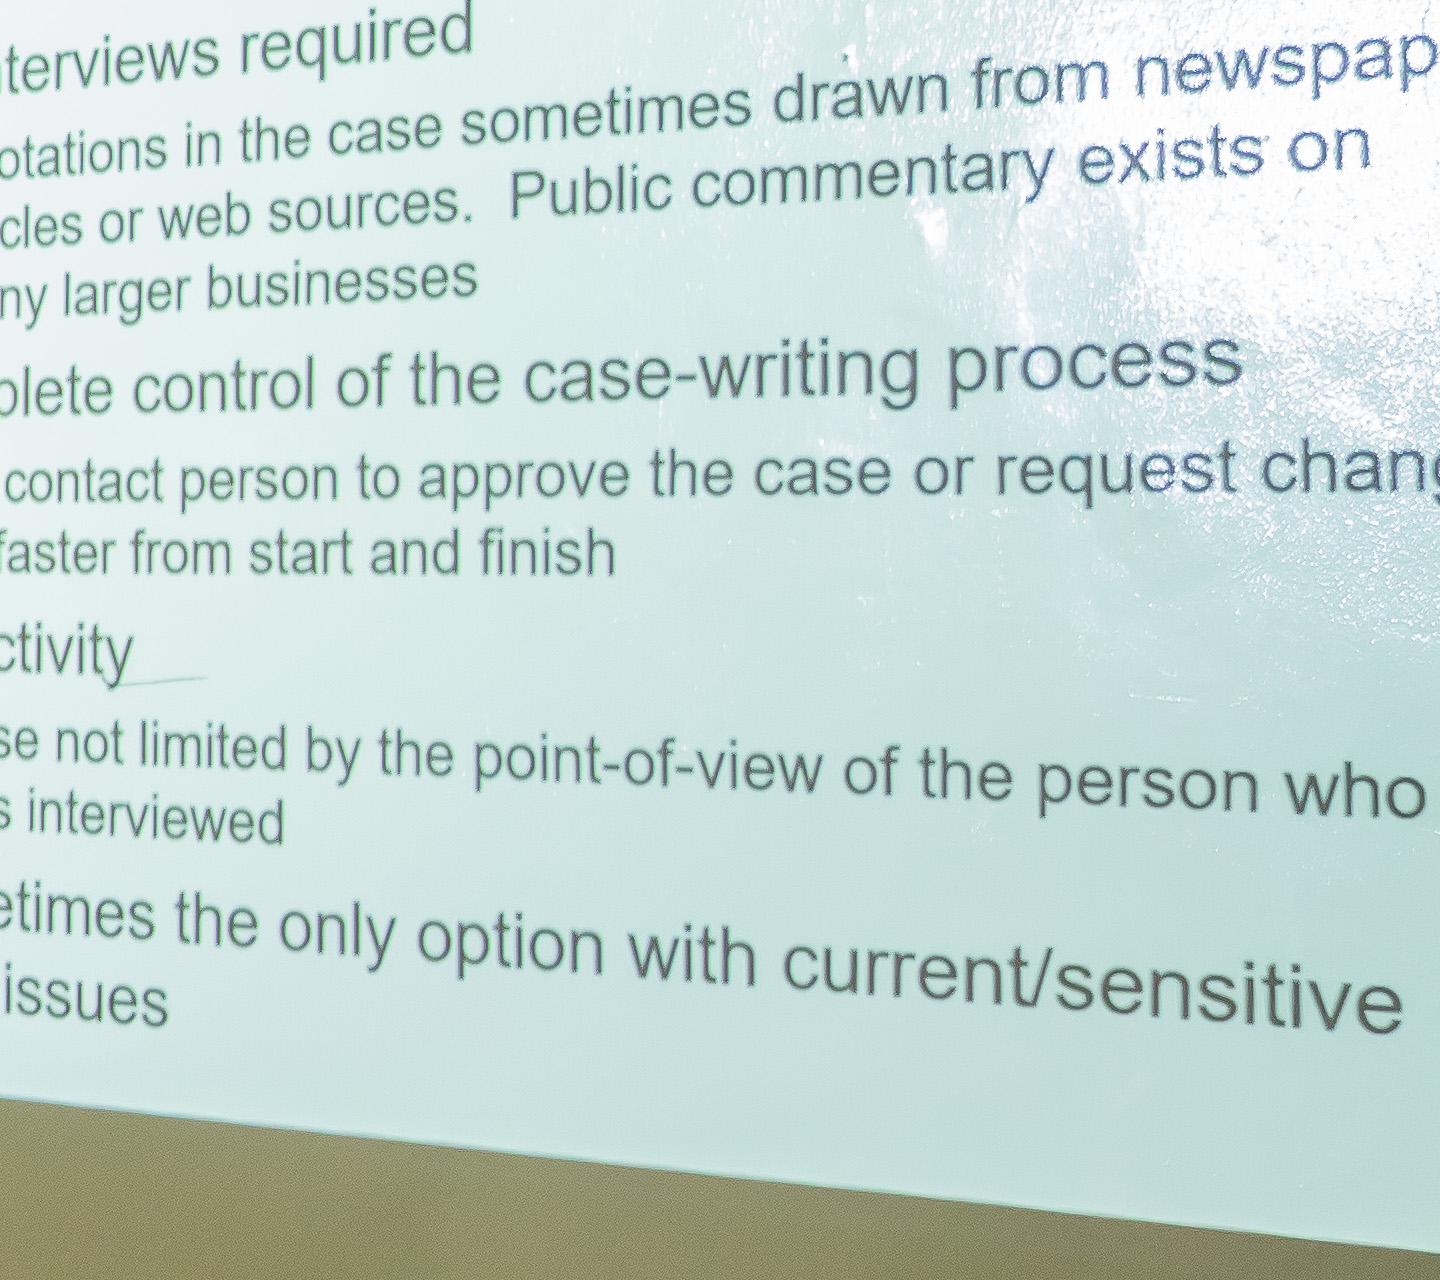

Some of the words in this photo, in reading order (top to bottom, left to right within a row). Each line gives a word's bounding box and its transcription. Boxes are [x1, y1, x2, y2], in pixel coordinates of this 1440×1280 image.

[187, 122, 221, 167] in
[240, 116, 310, 163] the
[329, 114, 442, 156] case
[462, 86, 751, 146] sometimes
[774, 72, 948, 123] drawn
[971, 56, 1108, 109] from
[1136, 34, 1439, 100] newspap
[100, 208, 143, 243] or
[158, 191, 251, 240] web
[270, 188, 471, 233] sources.
[512, 163, 672, 219] Public
[693, 144, 1054, 208] commentary
[1079, 124, 1268, 186] exists
[1288, 128, 1370, 172] on
[65, 272, 191, 326] larger
[209, 260, 478, 309] businesses
[134, 355, 314, 413] control
[338, 352, 392, 408] of
[410, 351, 501, 406] the
[525, 337, 918, 411] case-writing
[949, 338, 1244, 410] process
[5, 458, 163, 503] contact
[182, 465, 337, 514] person
[357, 454, 400, 500] to
[420, 461, 630, 512] approve
[650, 448, 733, 497] the
[755, 457, 891, 496] case
[915, 456, 974, 495] or
[998, 441, 1236, 509] request
[1262, 437, 1440, 504] chan
[131, 529, 231, 574] from
[251, 529, 352, 575] start
[371, 528, 459, 575] and
[480, 527, 614, 575] finish
[58, 721, 123, 764] not
[142, 720, 286, 770] limited
[308, 725, 361, 786] by
[379, 728, 454, 777] the
[476, 733, 823, 793] point-of-view
[845, 745, 900, 796] of
[919, 747, 1012, 801] the
[1040, 764, 1258, 818] person
[1284, 761, 1426, 819] who
[30, 791, 283, 845] interviewed
[6, 963, 168, 1027] issues
[176, 892, 258, 948] the
[280, 901, 396, 973] only
[419, 912, 603, 980] option
[629, 923, 755, 986] with
[784, 946, 1402, 1034] current/sensitive
